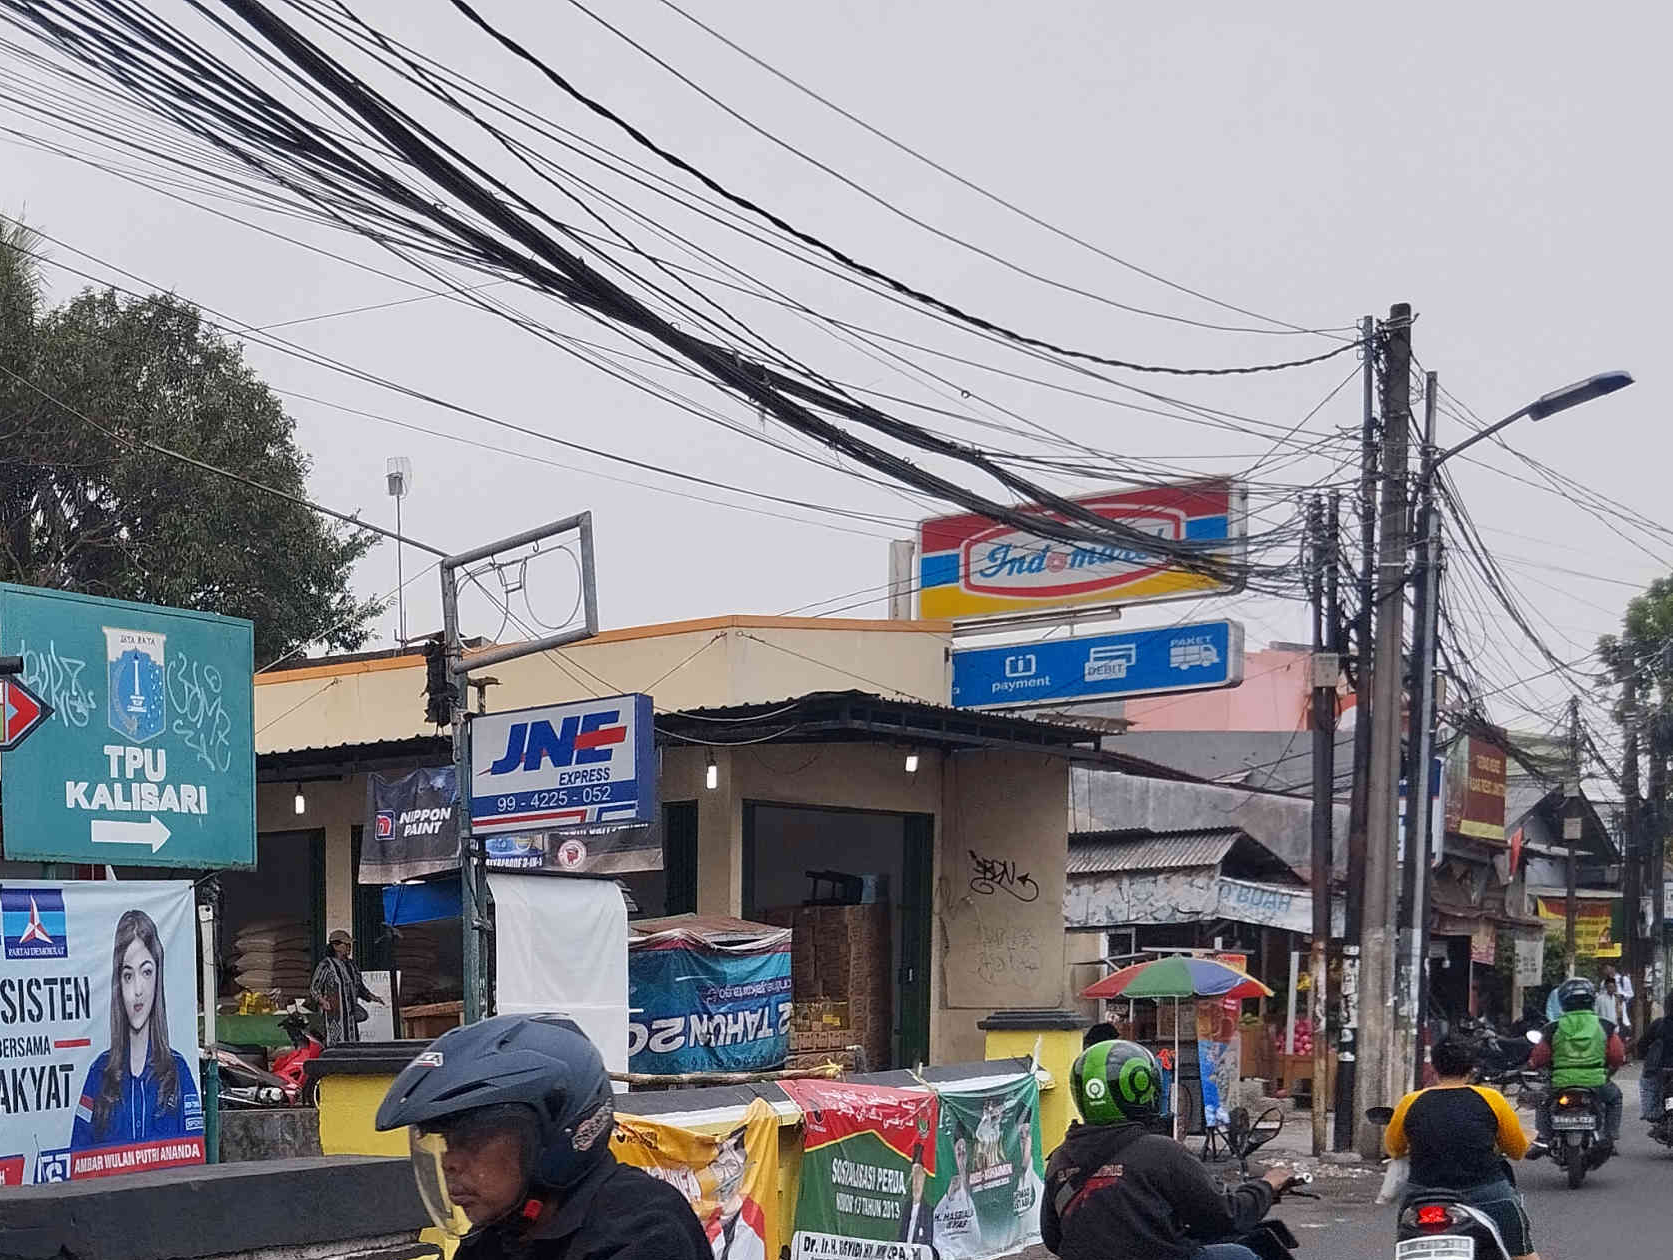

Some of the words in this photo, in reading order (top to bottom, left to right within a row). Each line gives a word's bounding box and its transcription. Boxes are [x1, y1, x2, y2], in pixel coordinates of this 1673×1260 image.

[991, 674, 1052, 693] payment
[1086, 662, 1125, 677] DEBIT
[487, 709, 627, 776] JNE
[104, 744, 167, 783] TPU
[558, 767, 612, 786] EXPRESS
[64, 780, 208, 815] KALISARI
[497, 796, 516, 812] 99
[530, 790, 568, 810] 4225
[583, 785, 612, 803] 052
[399, 807, 452, 825] NIPPON
[403, 820, 443, 837] PAINT
[688, 1006, 775, 1049] TAHUN
[75, 1154, 104, 1175] AMBAR
[104, 1150, 135, 1168] WULAN
[136, 1148, 159, 1165] PUTRI
[160, 1143, 201, 1162] ANANDA
[877, 1166, 908, 1196] PERDA
